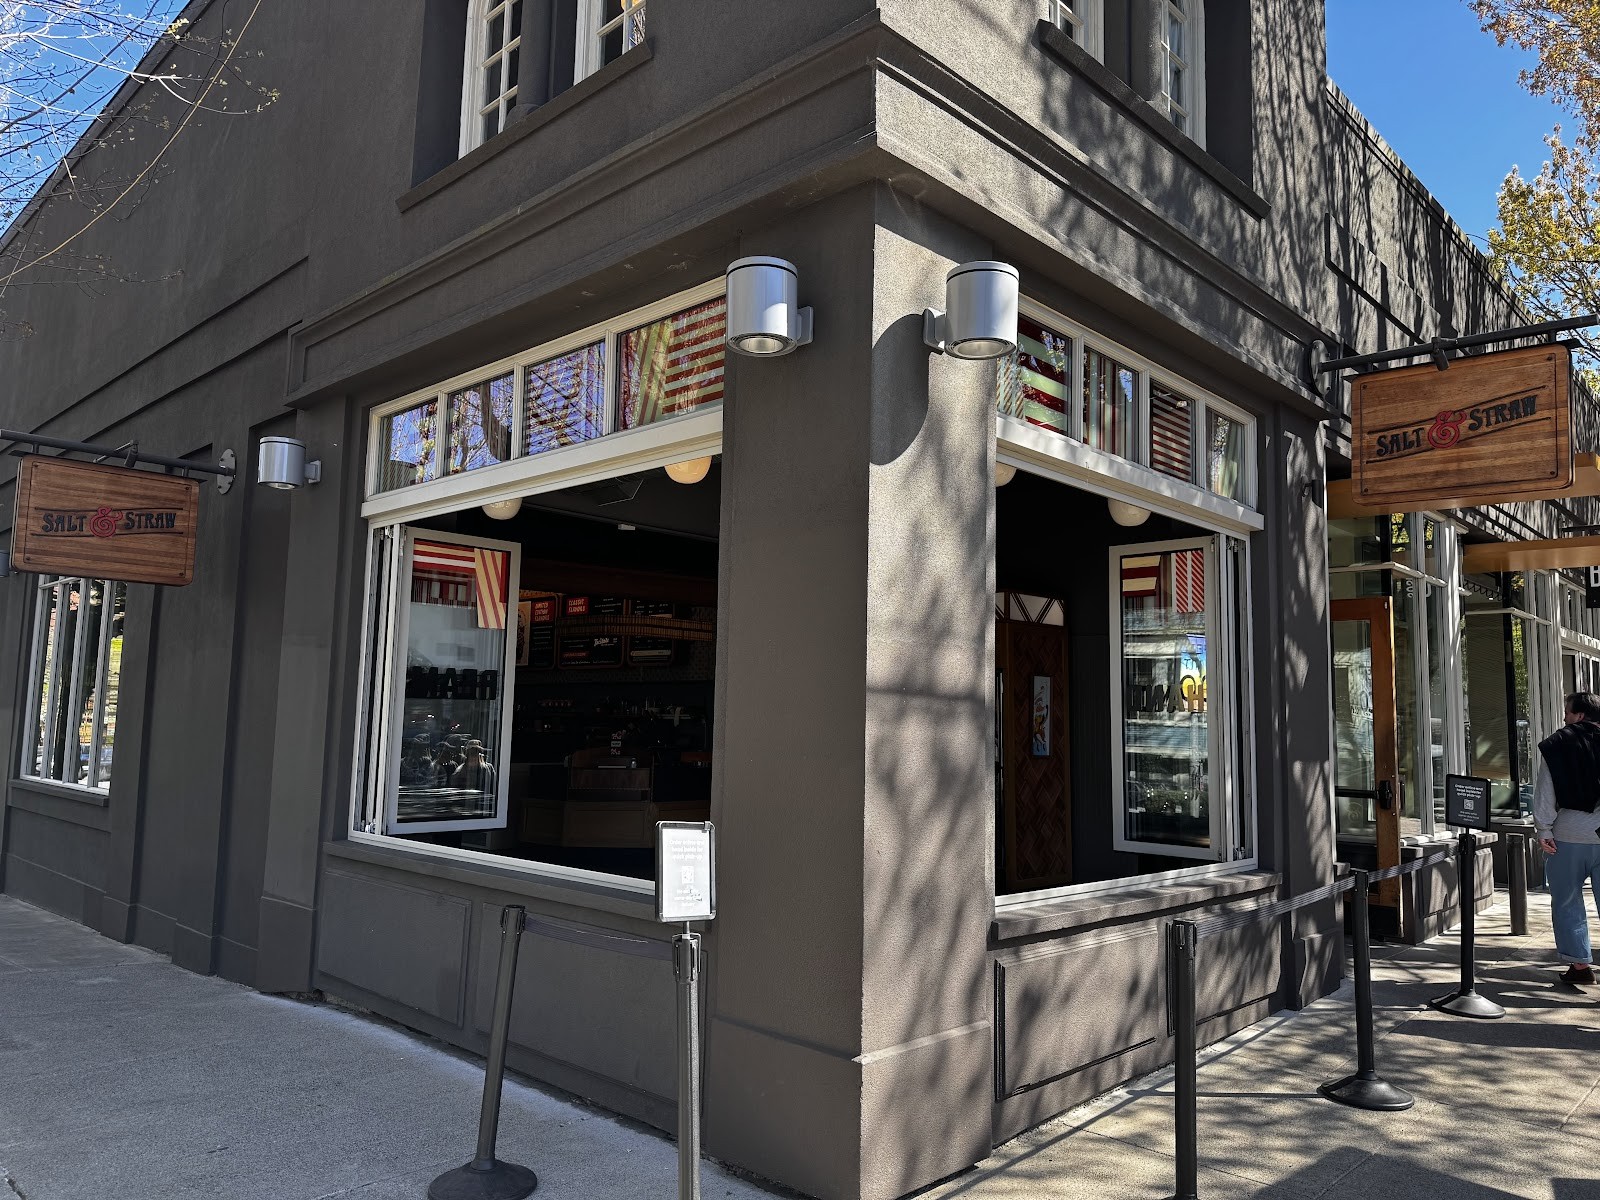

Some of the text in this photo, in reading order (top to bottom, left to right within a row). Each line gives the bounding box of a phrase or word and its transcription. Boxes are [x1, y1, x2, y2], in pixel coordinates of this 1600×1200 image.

[1376, 395, 1538, 456] SALT & STRAW
[41, 506, 176, 538] SALT & STRAW
